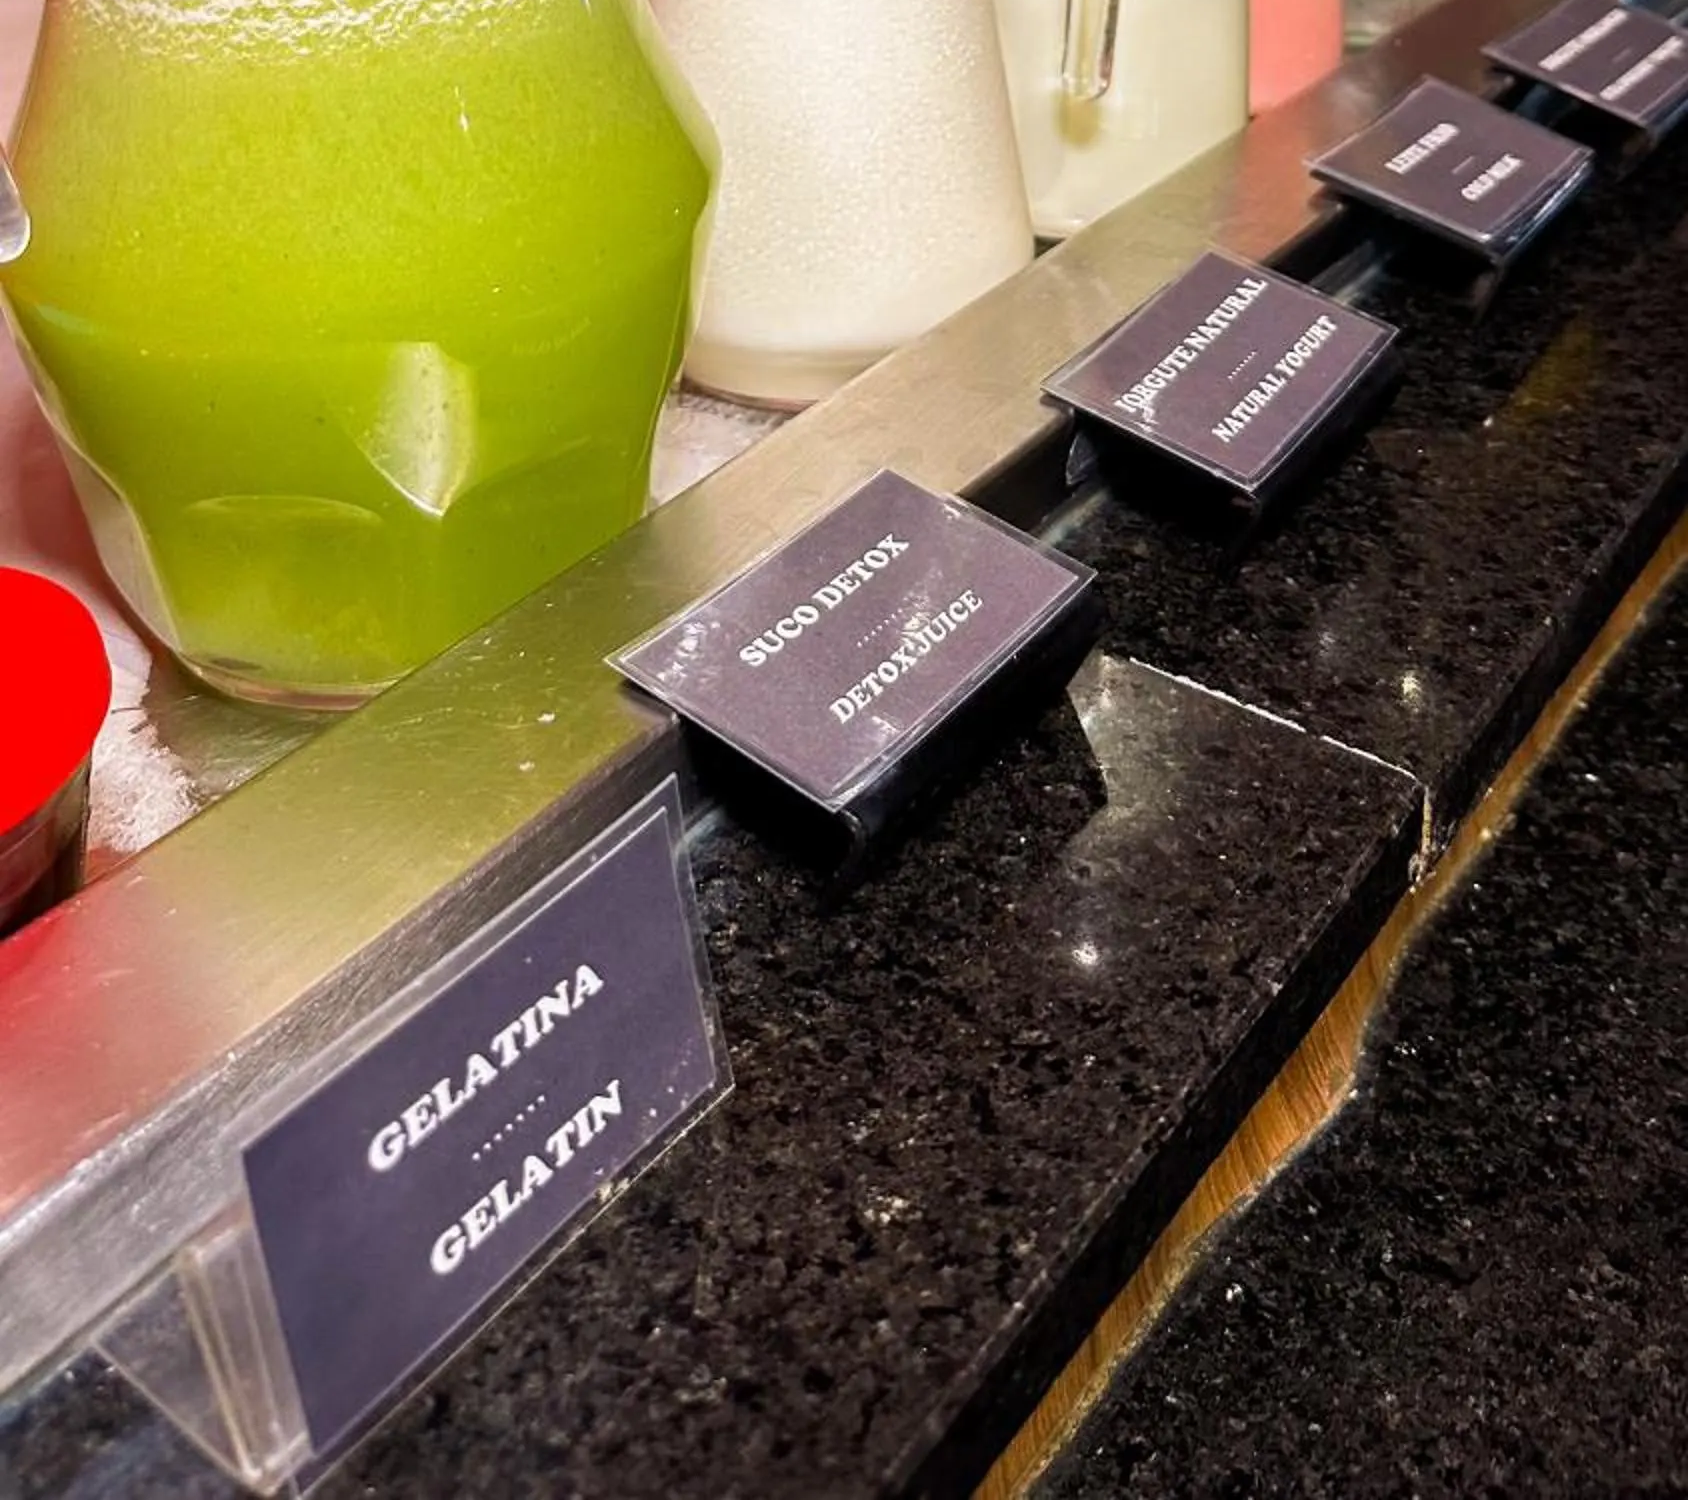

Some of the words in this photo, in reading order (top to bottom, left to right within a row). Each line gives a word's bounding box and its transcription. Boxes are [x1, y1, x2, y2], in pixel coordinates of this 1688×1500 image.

[1184, 277, 1268, 350] NATURAL
[1212, 374, 1286, 443] NATURAL
[1276, 315, 1338, 378] YOGURT
[739, 603, 820, 668] SUCO
[812, 533, 910, 611] DETOX
[829, 645, 917, 724] DETOX
[912, 589, 984, 656] JUICE
[368, 964, 604, 1171] GELATINA
[430, 1080, 622, 1275] GELATIN
